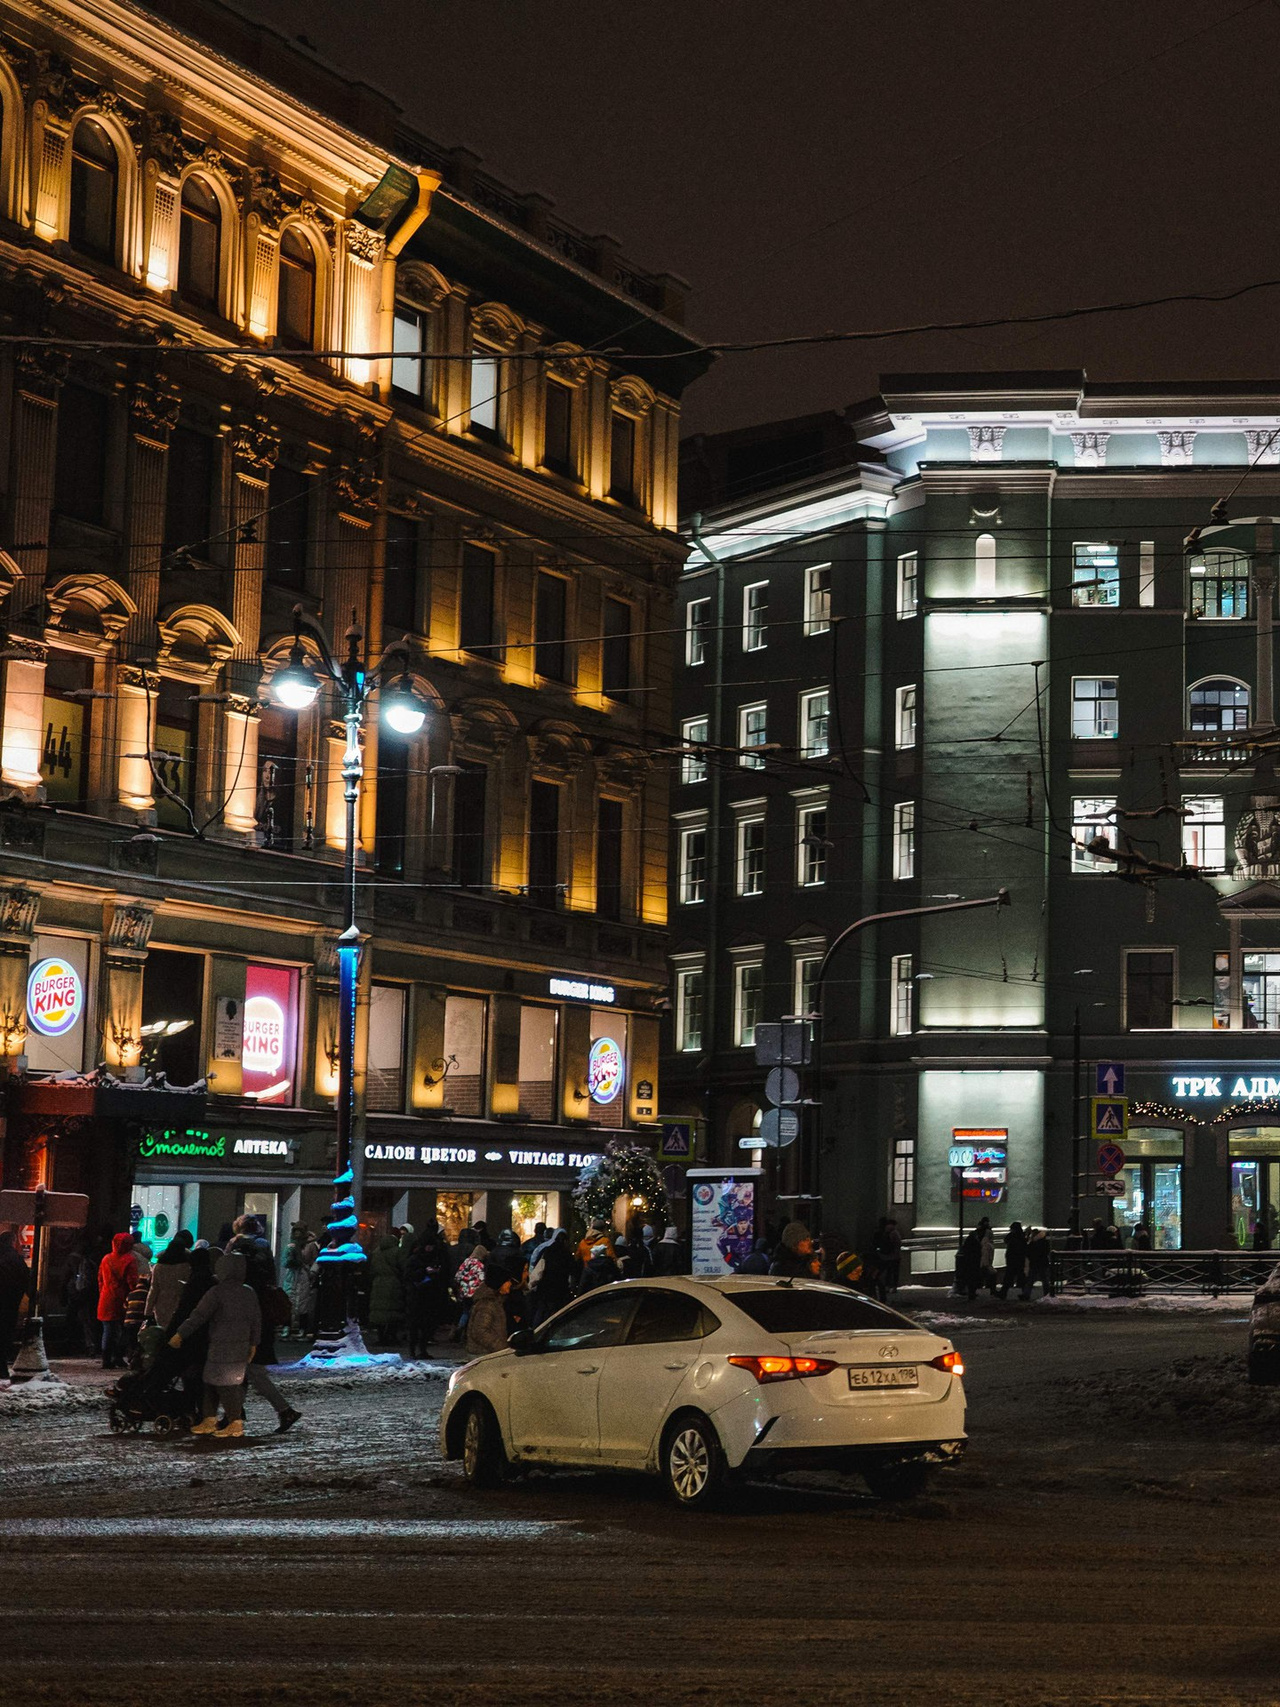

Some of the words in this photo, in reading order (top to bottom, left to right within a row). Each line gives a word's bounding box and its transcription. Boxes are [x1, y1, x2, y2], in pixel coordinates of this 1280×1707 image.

[34, 976, 76, 997] BURGER
[33, 989, 76, 1017] KING
[242, 1020, 280, 1036] BURGER
[242, 1036, 280, 1055] KING
[593, 1051, 618, 1071] BURGER
[1172, 1077, 1222, 1097] ТРК
[233, 1139, 288, 1155] АПТЕКА
[364, 1145, 415, 1160] САЛОН
[420, 1147, 477, 1164] ЦВЕТОВ
[509, 1150, 564, 1166] VINTAGE
